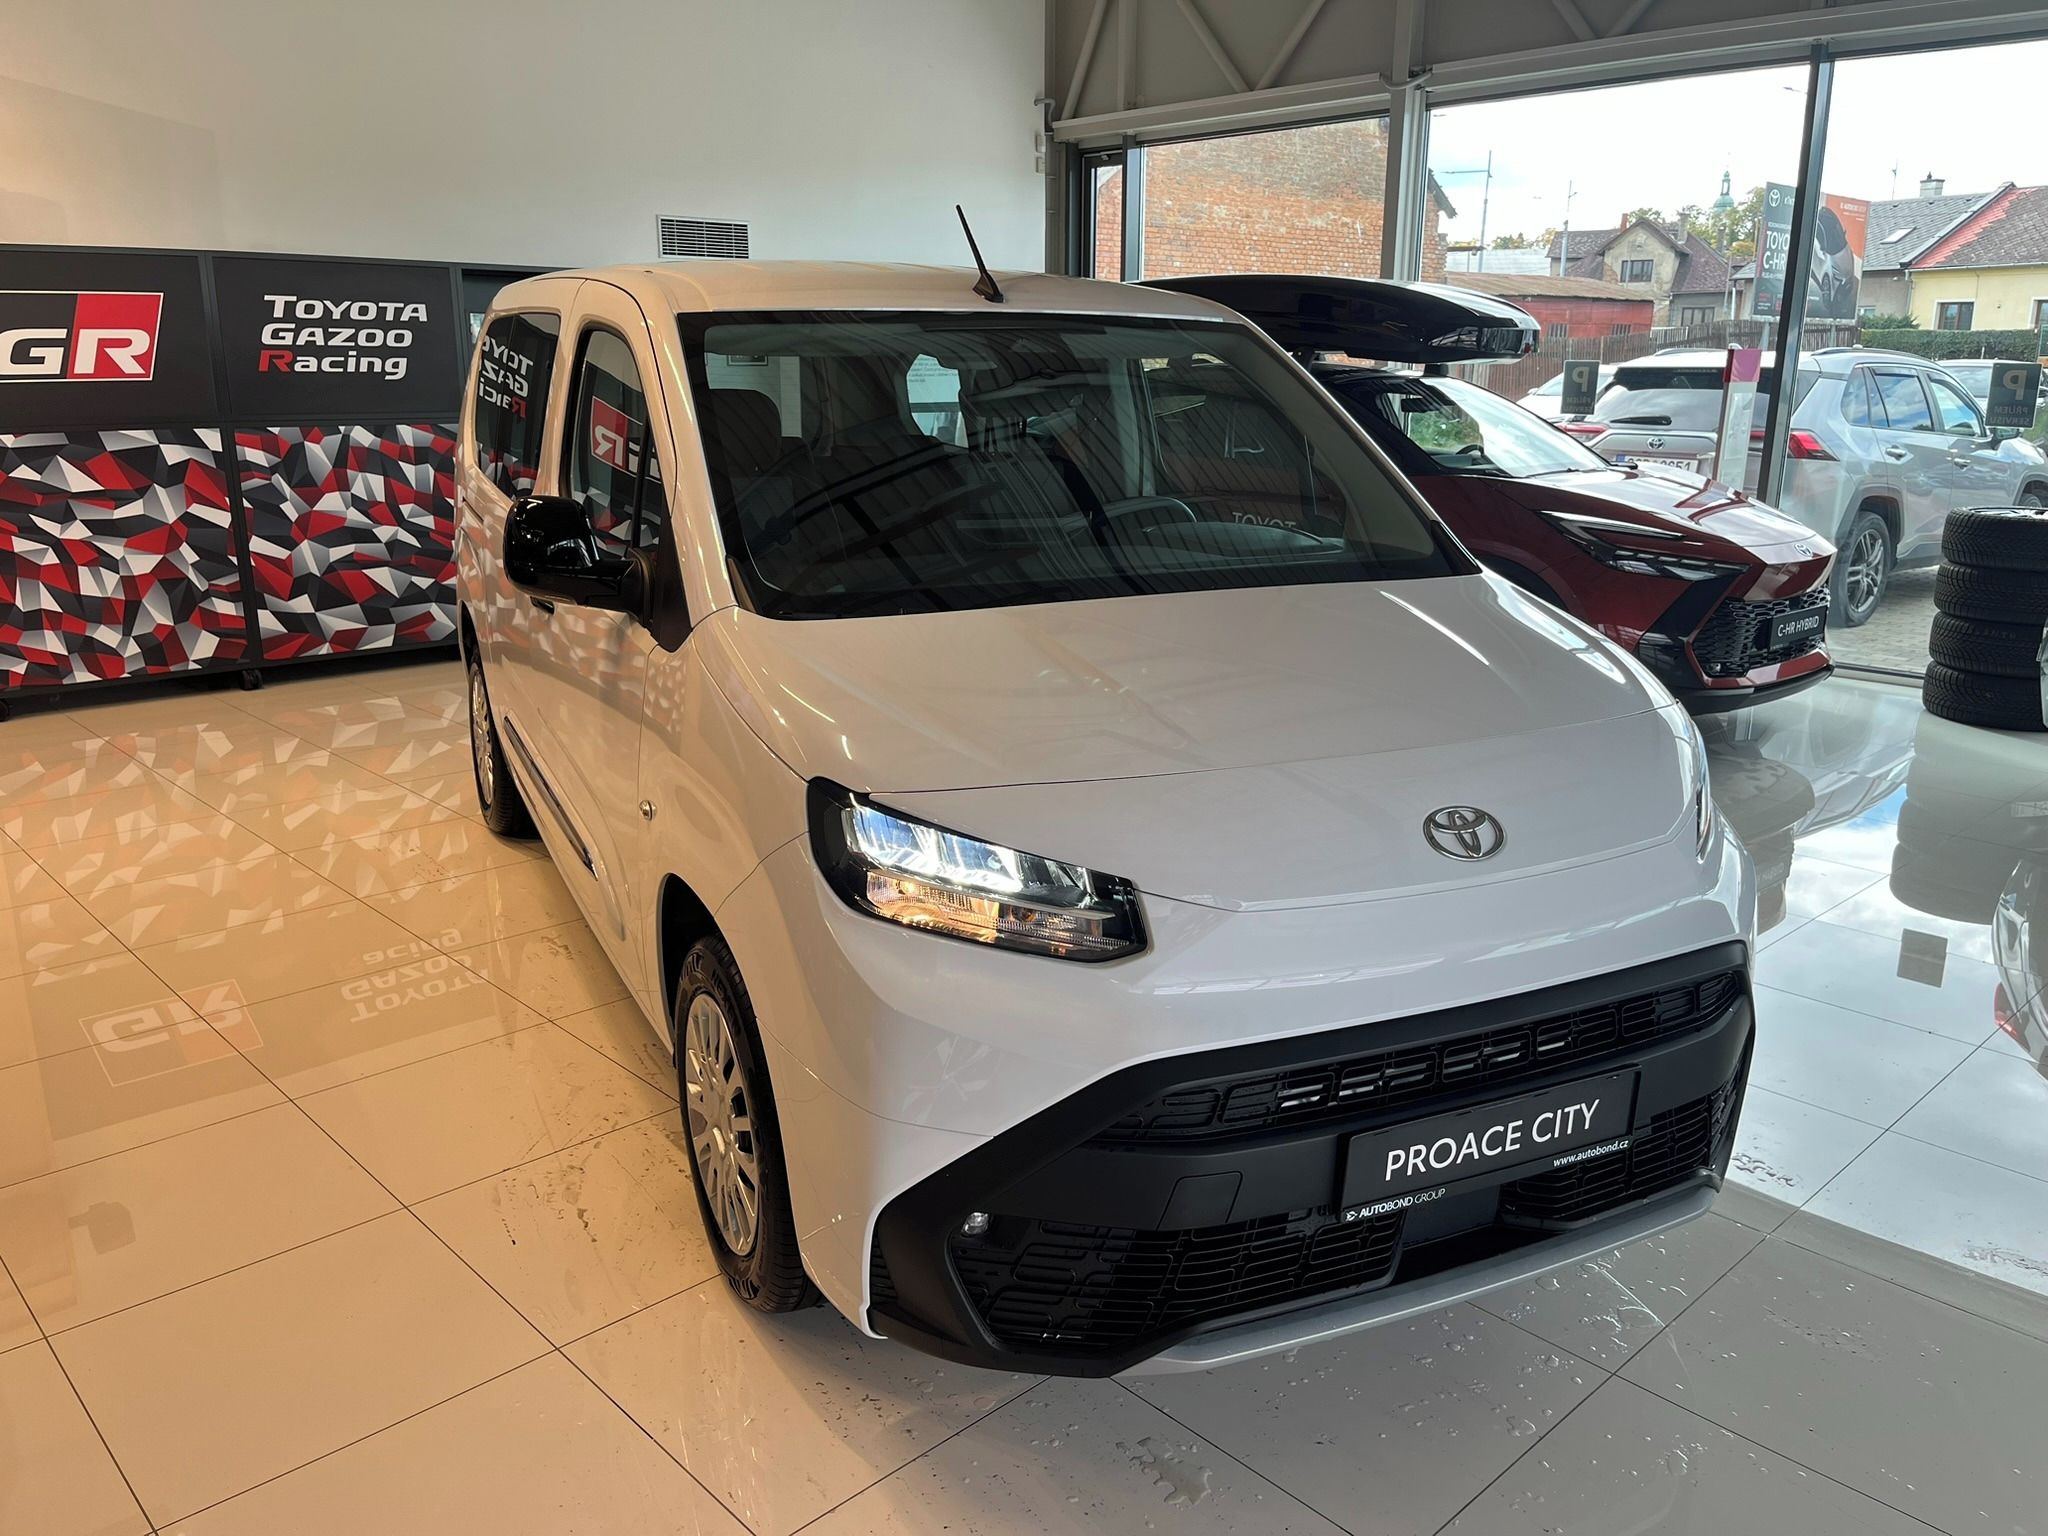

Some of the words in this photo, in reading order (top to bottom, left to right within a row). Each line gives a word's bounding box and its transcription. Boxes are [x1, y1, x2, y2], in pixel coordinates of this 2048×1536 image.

[264, 294, 428, 322] TOYOTA
[260, 323, 413, 347] GAZOO
[0, 328, 151, 375] GR
[258, 350, 408, 380] Racing
[1777, 621, 1795, 637] C-HR
[1796, 615, 1819, 632] HYBRID
[1384, 1119, 1523, 1181] PROACE
[1531, 1098, 1600, 1143] CITY
[1553, 1139, 1629, 1168] www.autobond.cz
[1358, 1196, 1413, 1218] AUTOBOND
[1414, 1188, 1446, 1205] GROUP
